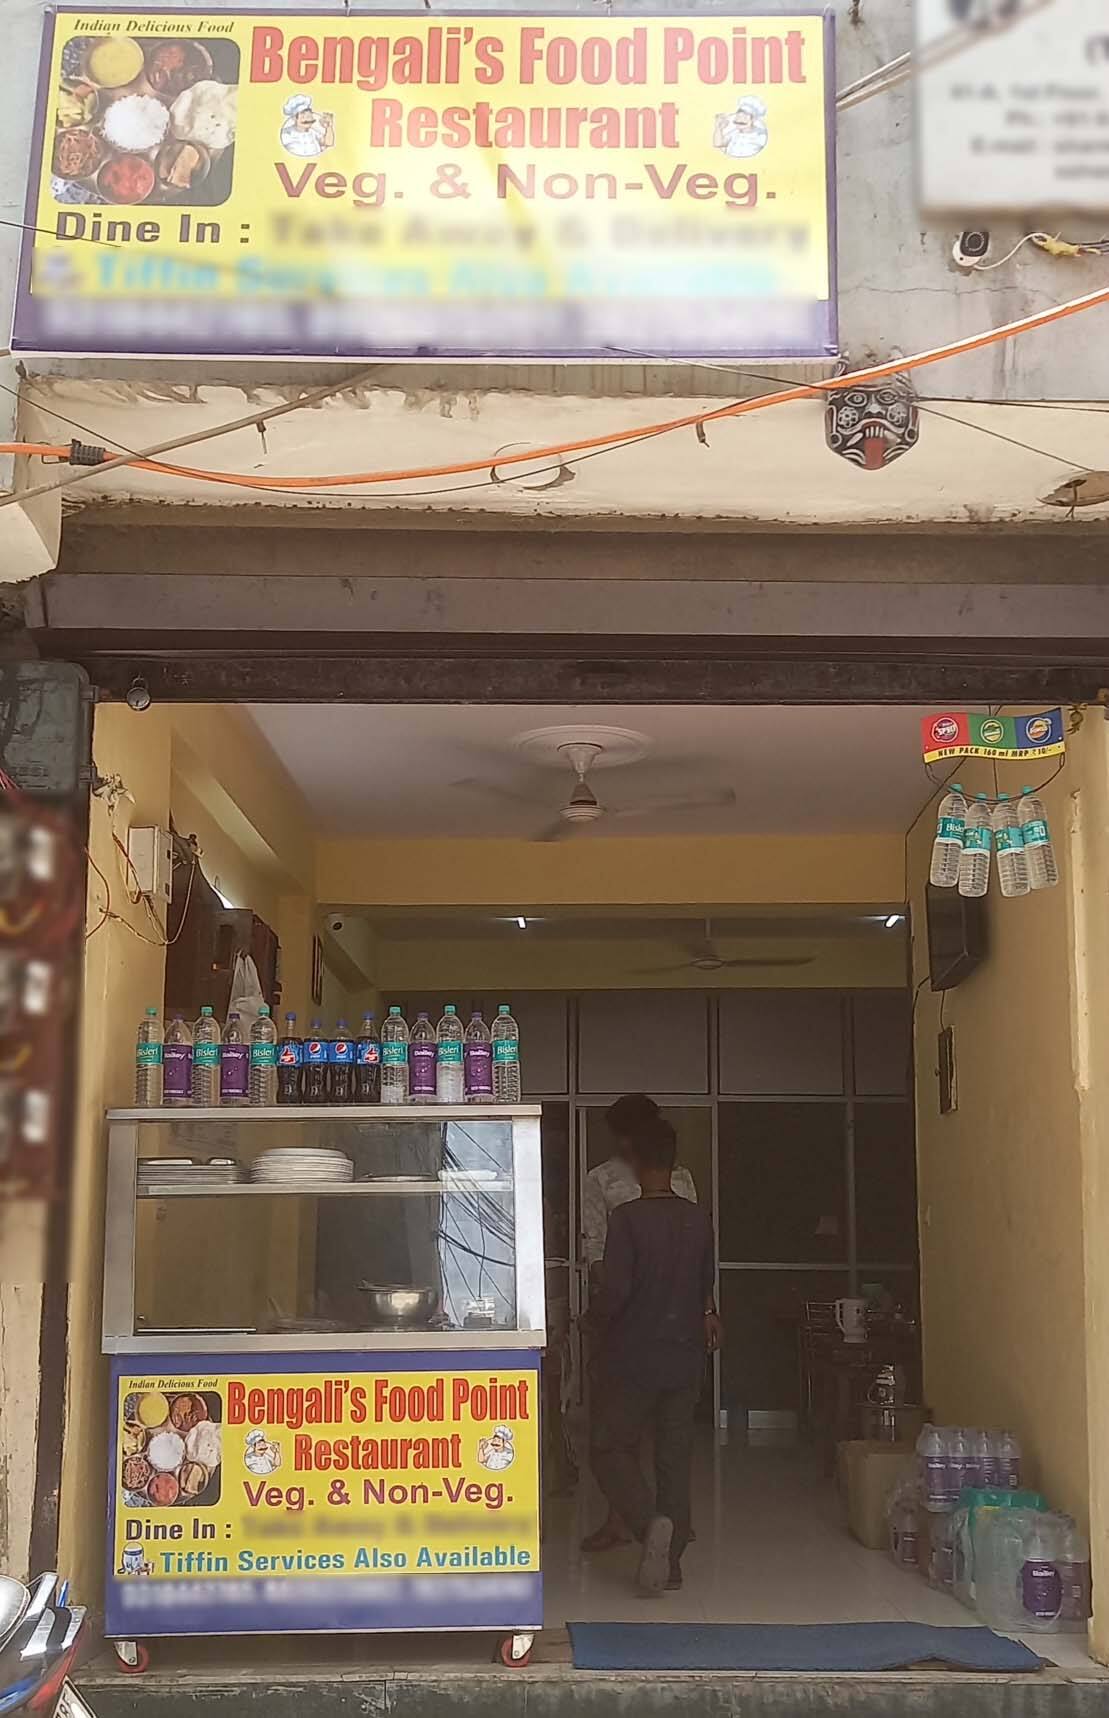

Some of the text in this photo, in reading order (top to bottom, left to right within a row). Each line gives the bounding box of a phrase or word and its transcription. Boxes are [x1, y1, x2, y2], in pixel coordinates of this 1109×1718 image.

[73, 19, 235, 34] Indian Delicious Food
[249, 26, 807, 91] Bengali's Food Point
[370, 101, 680, 148] Restaurant
[274, 162, 777, 208] Veg. & Non-Veg.
[55, 211, 161, 243] Dine
[937, 749, 956, 757] NEW
[960, 747, 980, 755] PACK
[1011, 749, 1029, 757] MRP
[129, 1379, 218, 1389] Indian Delicious Food
[228, 1377, 530, 1430] Bengali's Food Point
[294, 1434, 462, 1471] Restaurant
[243, 1477, 513, 1511] Veg. & Non-Veg.
[125, 1519, 183, 1541] Dine
[160, 1545, 531, 1573] Tiffin Services Also Available
